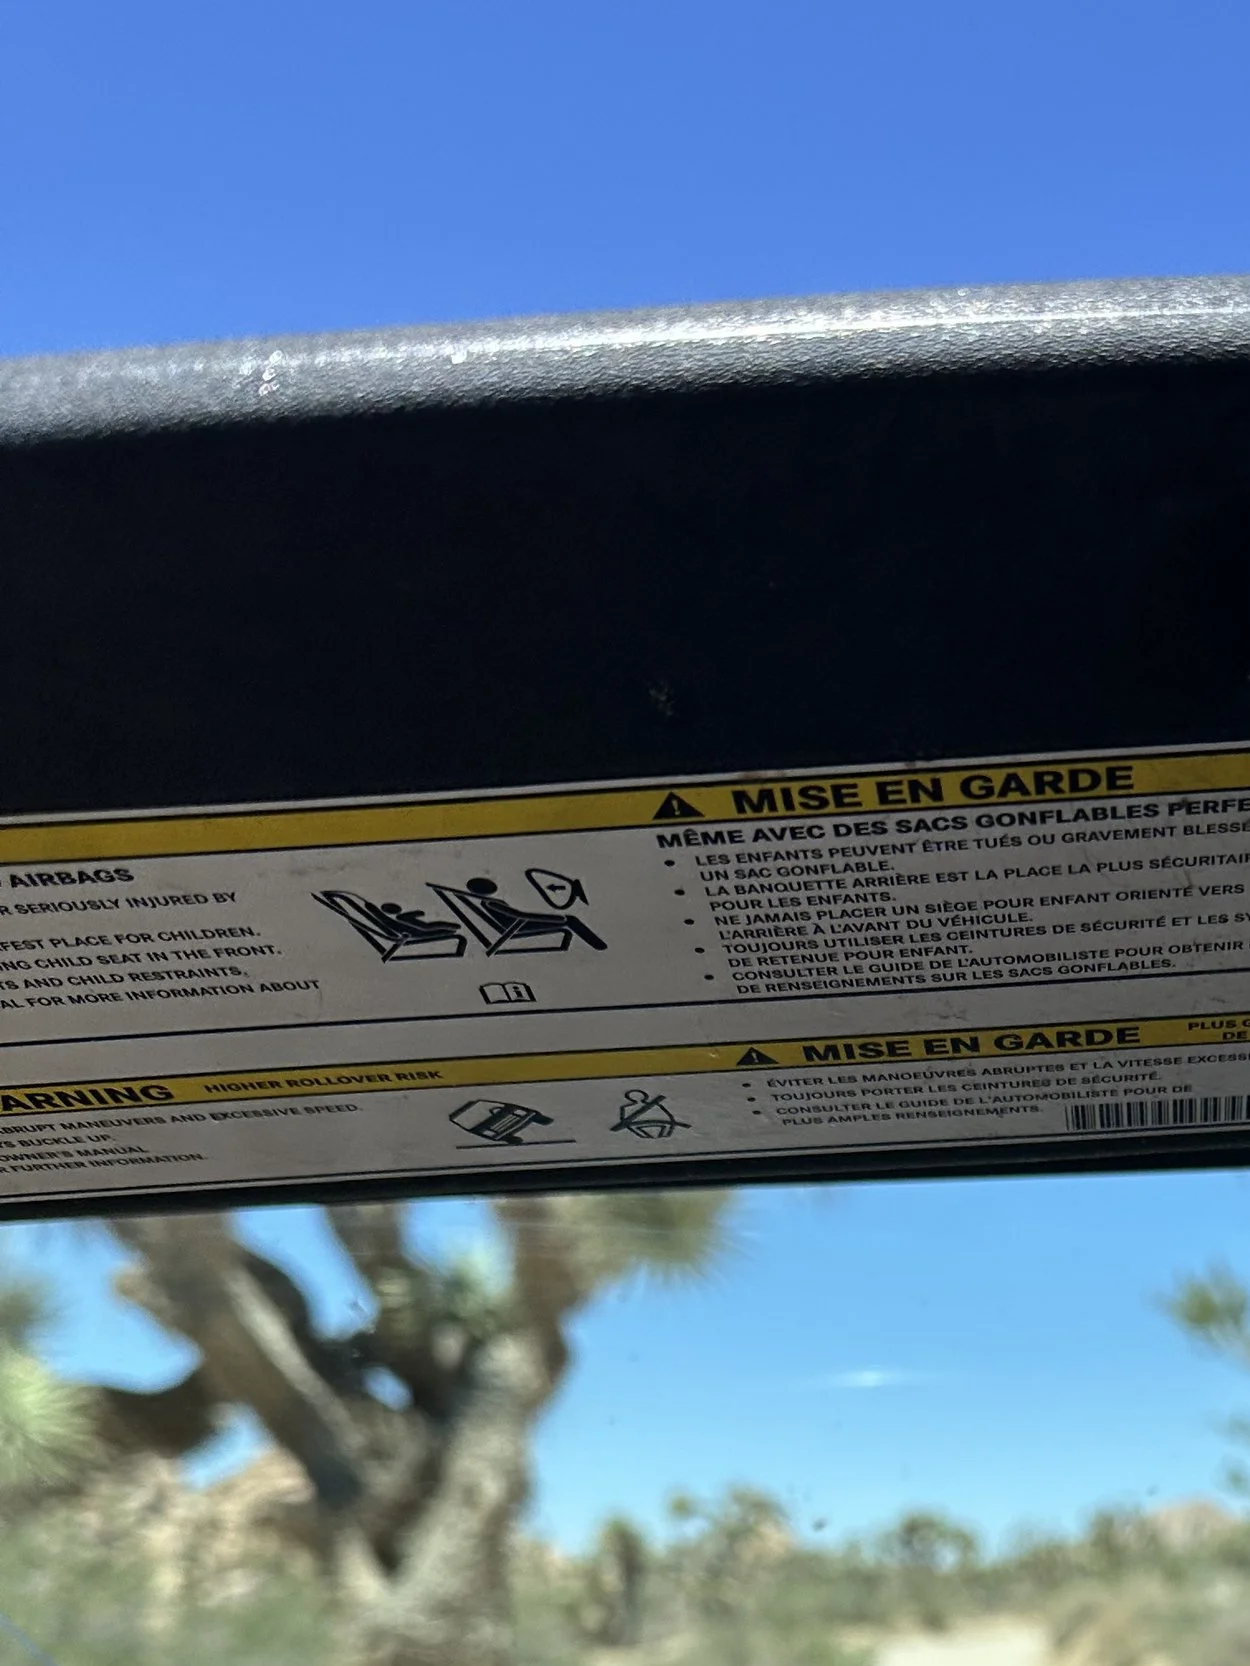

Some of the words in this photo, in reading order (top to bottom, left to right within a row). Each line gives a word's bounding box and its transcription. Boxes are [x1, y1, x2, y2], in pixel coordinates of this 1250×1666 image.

[731, 783, 863, 814] MISE
[875, 778, 944, 805] EN
[958, 766, 1133, 800] GARDE
[655, 829, 745, 848] MÊME
[749, 824, 826, 842] AVEC
[832, 821, 888, 837] DES
[894, 815, 968, 833] SACS
[974, 803, 1159, 828] GONFLABLES
[695, 855, 731, 867] LES
[735, 849, 824, 864] ENFANTS
[827, 843, 917, 859] PEUVENT
[922, 839, 968, 853] ÊTRE
[973, 835, 1022, 850] TUÉS
[1027, 834, 1055, 846] OU
[1061, 827, 1174, 844] GRAVEMENT
[9, 868, 134, 888] AIRBAGS
[699, 870, 729, 882] UN
[733, 868, 772, 880] SAC
[775, 861, 894, 877] GONFLABLE.
[704, 885, 730, 897] LA
[733, 878, 847, 895] BANQUETTE
[851, 872, 930, 888] ARRIÈRE
[935, 870, 969, 883] EST
[974, 869, 997, 880] LA
[1003, 865, 1061, 878] PLACE
[1068, 863, 1090, 874] LA
[1096, 860, 1143, 872] PLUS
[15, 899, 122, 915] SERIOUSLY
[127, 894, 208, 908] INJURED
[214, 892, 237, 902] BY
[709, 898, 763, 911] POUR
[767, 896, 802, 908] LES
[806, 890, 896, 905] ENFANTS.
[713, 914, 741, 926] NE
[745, 910, 812, 924] JAMAIS
[815, 905, 886, 919] PLACER
[891, 903, 919, 915] UN
[924, 898, 977, 913] SIÈGE
[983, 897, 1034, 909] POUR
[1040, 892, 1110, 906] ENFANT
[1115, 884, 1192, 902] ORIENTÉ
[1198, 884, 1244, 897] VERS
[721, 938, 819, 953] TOUJOURS
[823, 933, 904, 947] UTILISER
[908, 930, 942, 942] LES
[946, 924, 1047, 940] CEINTURES
[1052, 922, 1075, 934] DE
[1080, 914, 1165, 932] SÉCURITÉ
[1172, 916, 1191, 927] ET
[1197, 913, 1228, 925] LES
[811, 921, 825, 935] À
[906, 918, 932, 929] DU
[937, 912, 1032, 927] VÉHICULE.
[50, 936, 111, 948] PLACE
[115, 933, 153, 944] FOR
[157, 927, 259, 942] CHILDREN.
[34, 957, 93, 969] CHILD
[97, 953, 143, 965] SEAT
[148, 952, 168, 962] IN
[172, 949, 210, 960] THE
[214, 945, 280, 958] FRONT.
[727, 956, 753, 968] DE
[756, 951, 839, 966] RETENUE
[843, 948, 894, 961] POUR
[898, 943, 972, 957] ENFANT.
[730, 964, 838, 981] CONSULTER
[842, 963, 864, 974] LE
[867, 959, 924, 972] GUIDE
[928, 957, 952, 969] DE
[1115, 945, 1163, 958] POUR
[1168, 940, 1243, 954] OBTENIR
[22, 978, 64, 989] AND
[67, 974, 125, 986] CHILD
[129, 966, 246, 983] RESTRAINTS.
[736, 984, 761, 994] DE
[764, 974, 926, 992] RENSEIGNEMENTS
[930, 971, 967, 982] SUR
[972, 969, 1003, 980] LES
[1008, 966, 1052, 978] SACS
[1057, 959, 1175, 975] GONFLABLES.
[26, 996, 65, 1007] FOR
[68, 992, 122, 1005] MORE
[126, 984, 253, 1001] INFORMATION
[259, 979, 320, 992] ABOUT
[1188, 1020, 1237, 1031] PLUS
[1222, 1031, 1246, 1041] DE
[802, 1040, 912, 1061] MISE
[923, 1036, 980, 1054] EN
[993, 1027, 1140, 1050] GARDE
[205, 1080, 281, 1093] HIGHER
[287, 1074, 391, 1088] ROLLOVER
[396, 1071, 441, 1081] RISK
[766, 1076, 823, 1087] ÉVITER
[827, 1074, 857, 1084] LES
[861, 1067, 976, 1082] MANOEUVRES
[980, 1062, 1064, 1075] ABRUPTES
[1070, 1061, 1087, 1070] ET
[1093, 1059, 1112, 1069] LA
[1117, 1056, 1181, 1067] VITESSE
[770, 1088, 857, 1101] TOUJOURS
[860, 1085, 923, 1096] PORTER
[928, 1083, 957, 1093] LES
[961, 1078, 1051, 1091] CEINTURES
[1055, 1077, 1076, 1086] DE
[775, 1101, 871, 1114] CONSULTER
[875, 1100, 894, 1109] LE
[898, 1097, 948, 1108] GUIDE
[953, 1096, 974, 1105] DE
[1123, 1085, 1166, 1096] POUR
[1172, 1084, 1191, 1093] DE
[60, 1115, 165, 1130] MANEUVERS
[170, 1113, 206, 1123] AND
[210, 1107, 299, 1120] EXCESSIVE
[781, 1116, 823, 1126] PLUS
[826, 1112, 891, 1124] AMPLES
[18, 1136, 85, 1148] BUCKLE
[76, 1144, 147, 1157] MANUAL
[10, 1160, 86, 1173] FURTHER
